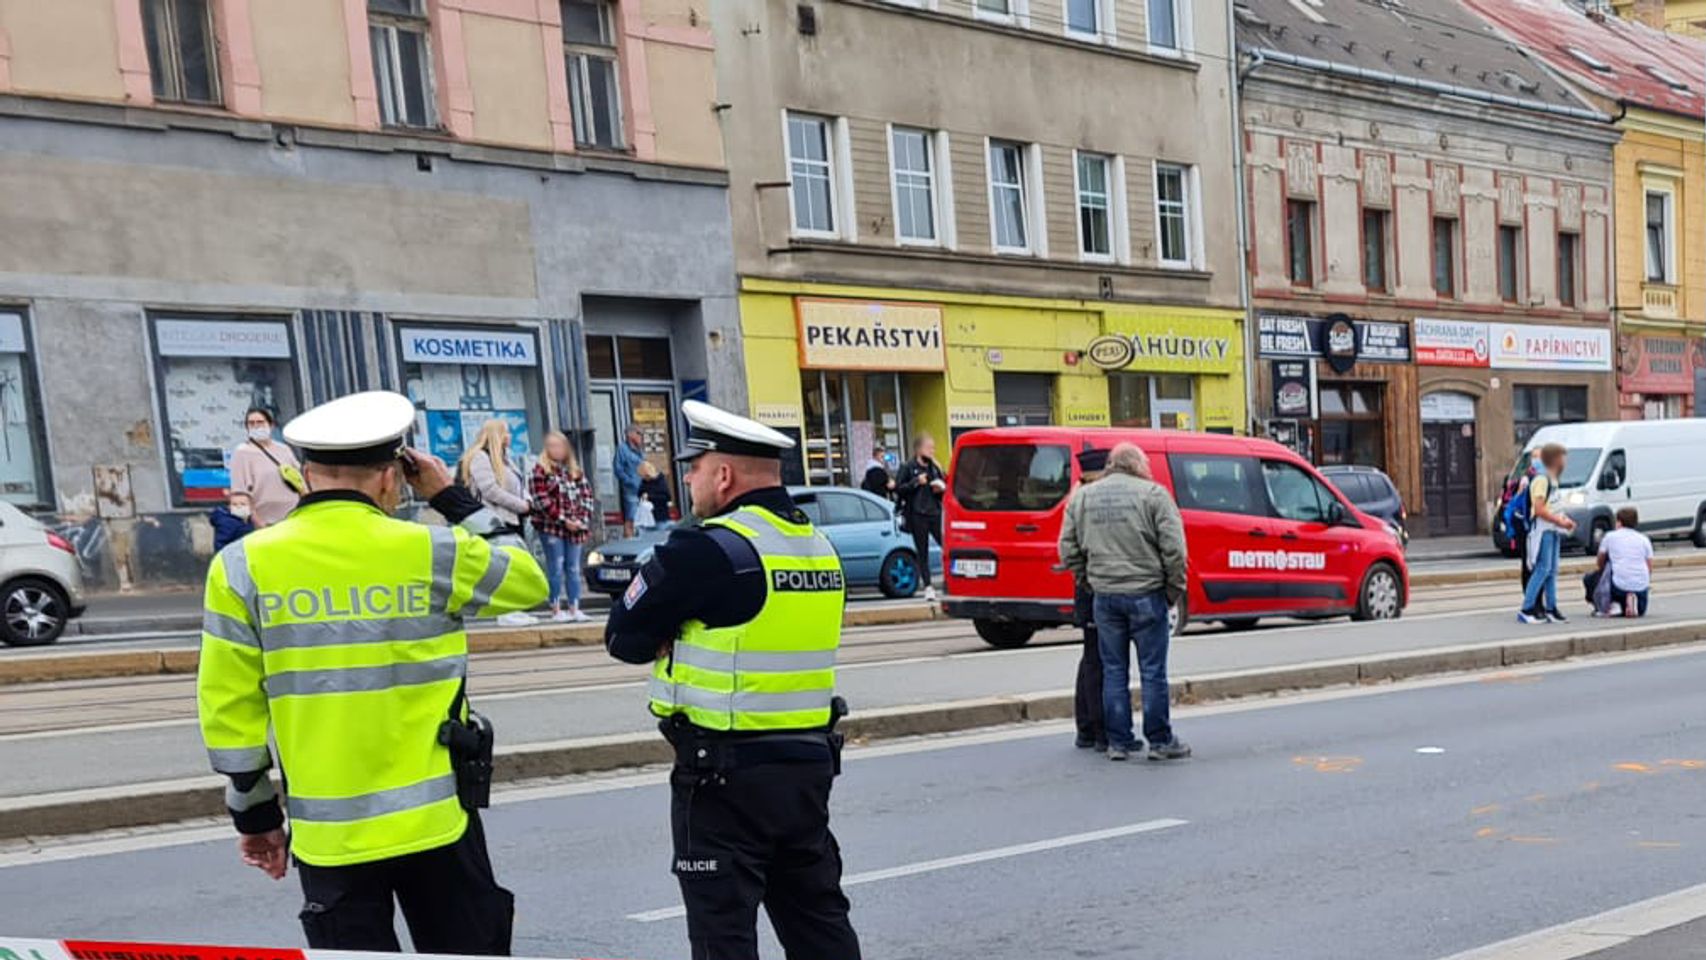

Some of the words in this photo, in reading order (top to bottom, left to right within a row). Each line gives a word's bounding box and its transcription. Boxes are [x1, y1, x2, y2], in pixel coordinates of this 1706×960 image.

[807, 322, 940, 349] PEKAŘSTVÍ
[1131, 331, 1228, 360] AHŮDKY
[1525, 333, 1601, 356] PAPÍRNICTVÍ
[413, 337, 527, 359] KOSMETIKA
[775, 570, 841, 589] POLICIE
[257, 583, 427, 624] POLICIE
[677, 859, 719, 872] POLICIE
